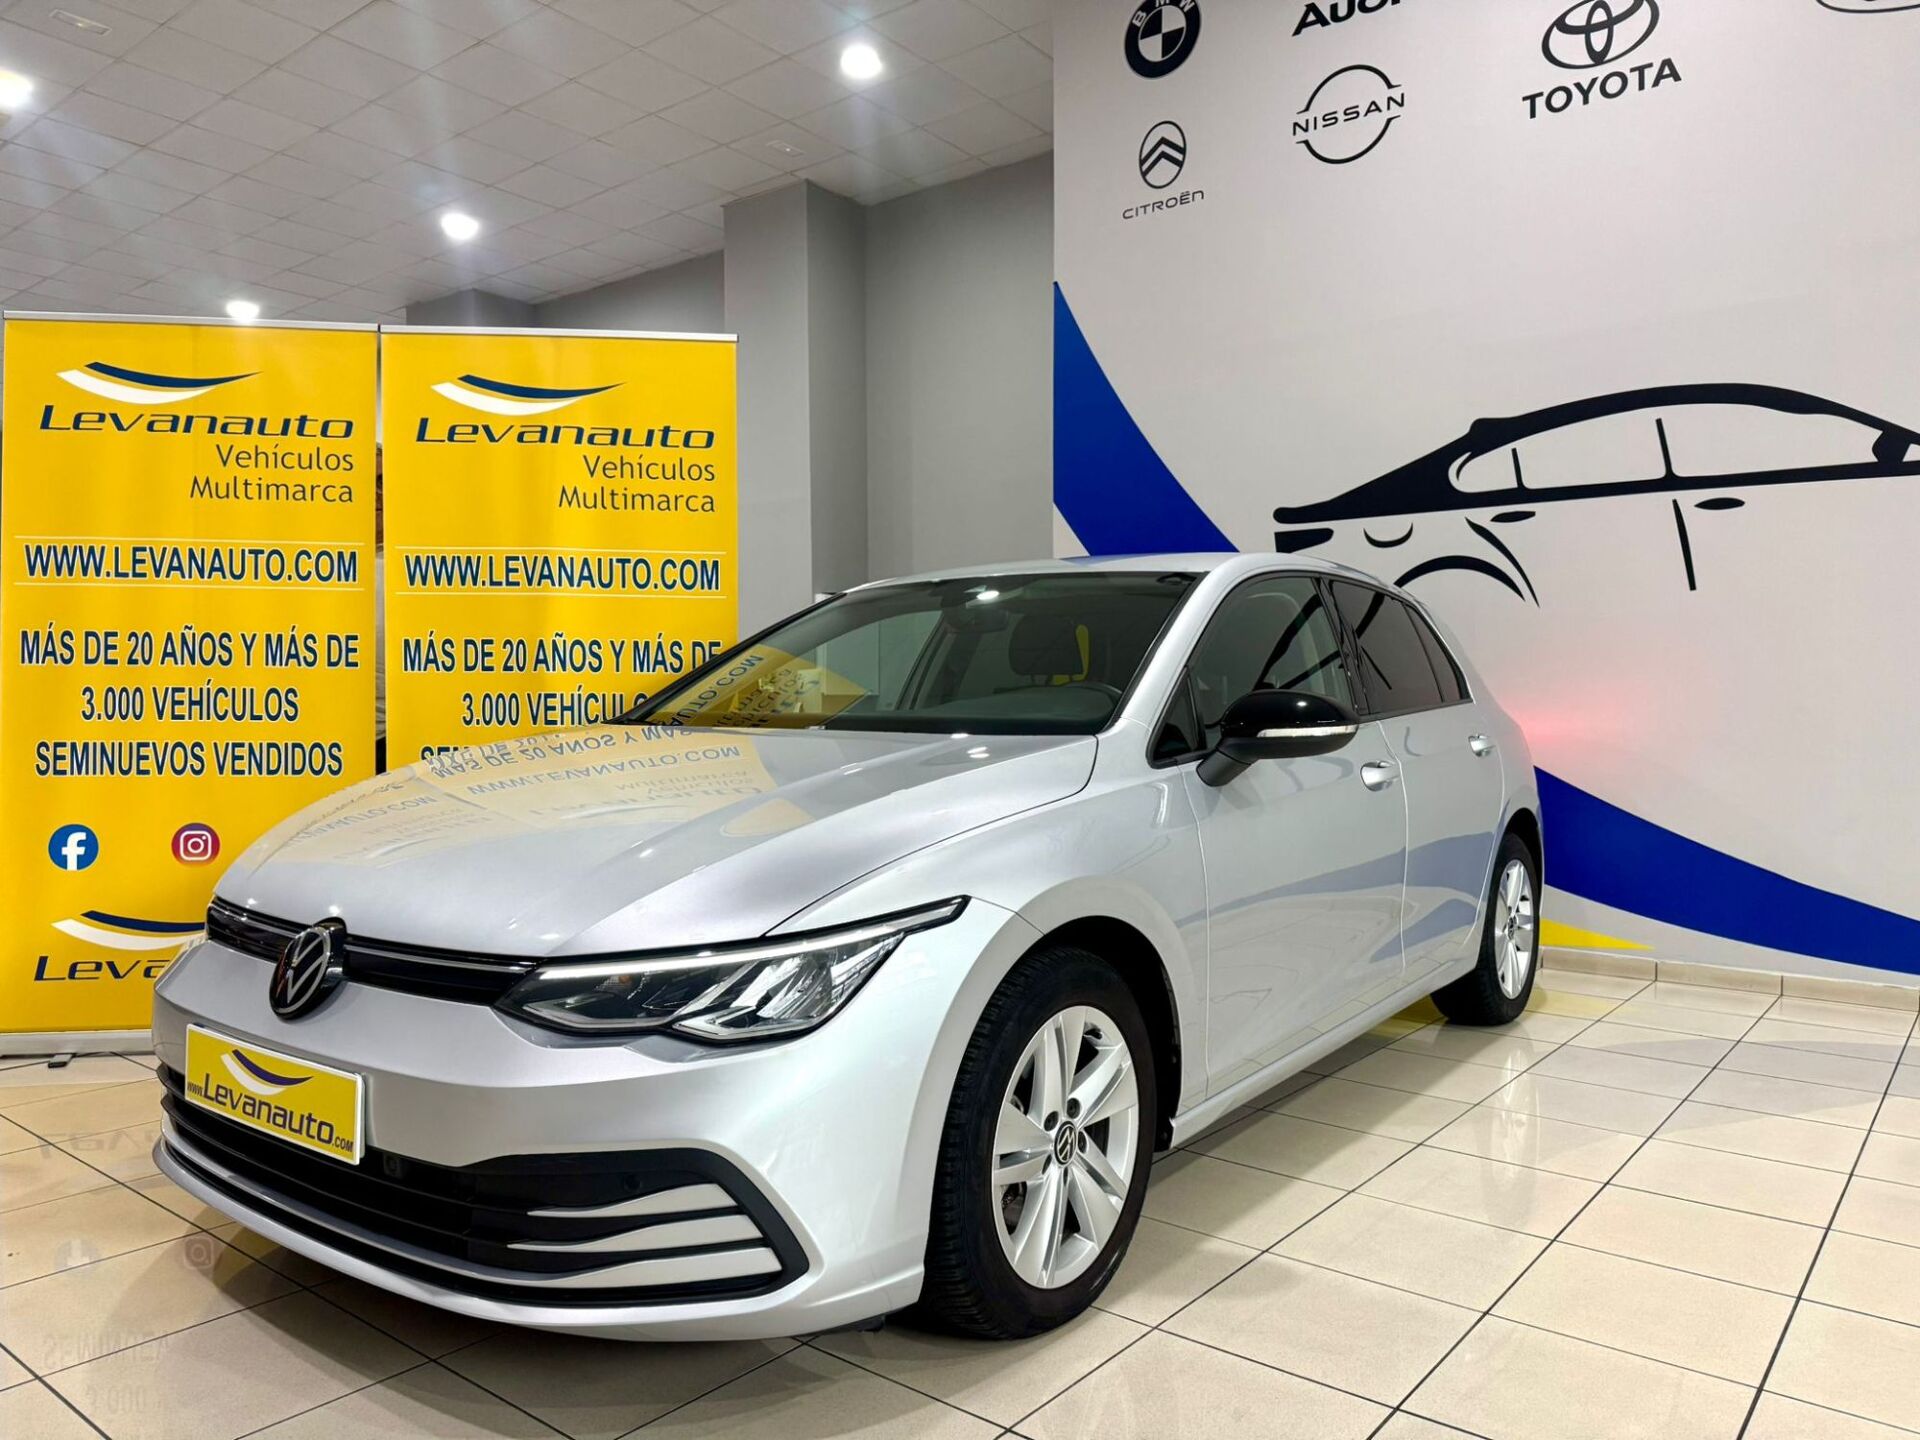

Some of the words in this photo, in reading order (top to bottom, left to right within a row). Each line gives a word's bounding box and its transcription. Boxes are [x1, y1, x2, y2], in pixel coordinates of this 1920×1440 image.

[1521, 57, 1683, 119] TOYOTA
[1292, 92, 1405, 136] NISSAN
[1122, 189, 1205, 220] CITROËN
[40, 404, 354, 438] Levanauto
[415, 417, 715, 449] Levanauto
[216, 444, 354, 472] Vehículos
[583, 455, 715, 482] Vehículos
[190, 475, 354, 503] Multimarca
[559, 486, 715, 513] Multimarca
[24, 544, 357, 582] WWW.LEVANAUTO.COM
[404, 555, 719, 591] WWW.LEVANAUTO.COM
[20, 623, 74, 666] MÁS
[84, 631, 119, 667] DE
[127, 631, 153, 667] 20
[161, 625, 233, 667] AÑOS
[240, 633, 257, 667] Y
[265, 627, 318, 668] MÁS
[326, 634, 359, 668] DE
[403, 631, 455, 673] MÁS
[463, 638, 495, 673] DE
[502, 638, 527, 673] 20
[533, 633, 602, 674] AÑOS
[609, 640, 626, 673] Y
[632, 633, 684, 675] MÁS
[81, 686, 144, 722] 3.000
[152, 679, 299, 722] VEHÍCULOS
[462, 692, 520, 726] 3.000
[35, 741, 205, 777] SEMINUEVOS
[213, 742, 343, 777] VENDIDOS
